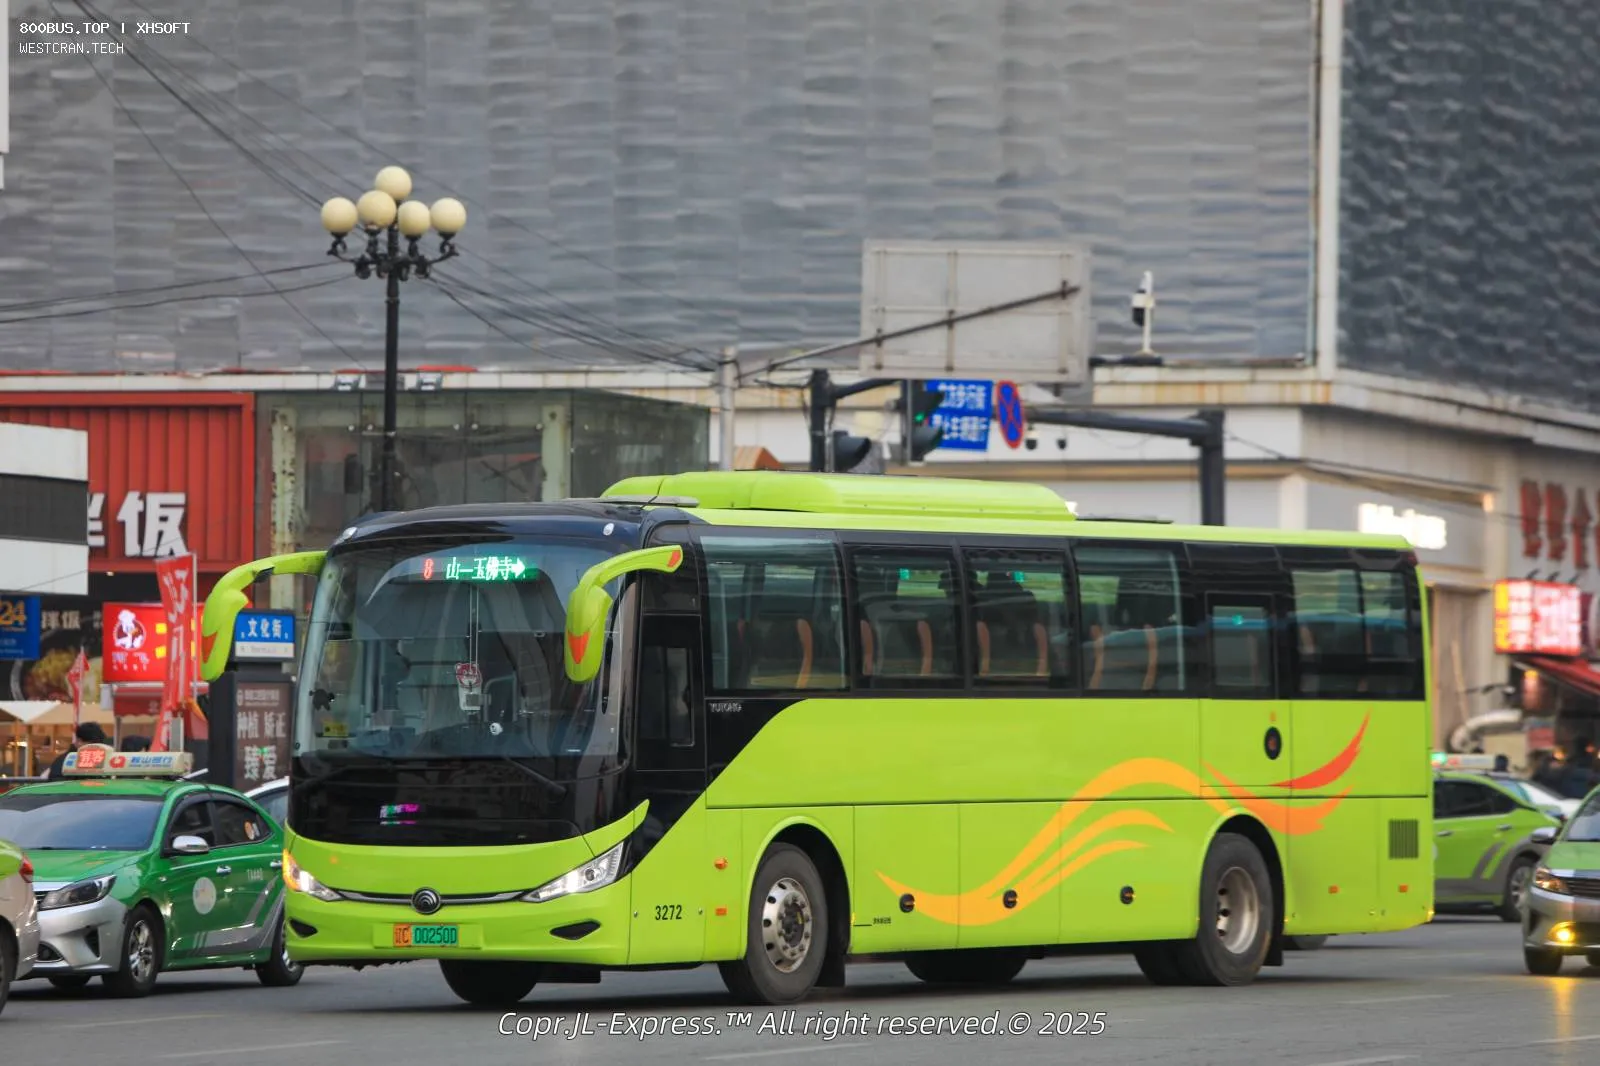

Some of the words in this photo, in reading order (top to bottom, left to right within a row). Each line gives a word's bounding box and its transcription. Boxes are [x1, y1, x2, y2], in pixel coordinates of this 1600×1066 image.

[423, 558, 435, 581] 8
[247, 617, 282, 639] 文化街
[655, 904, 683, 921] 3272
